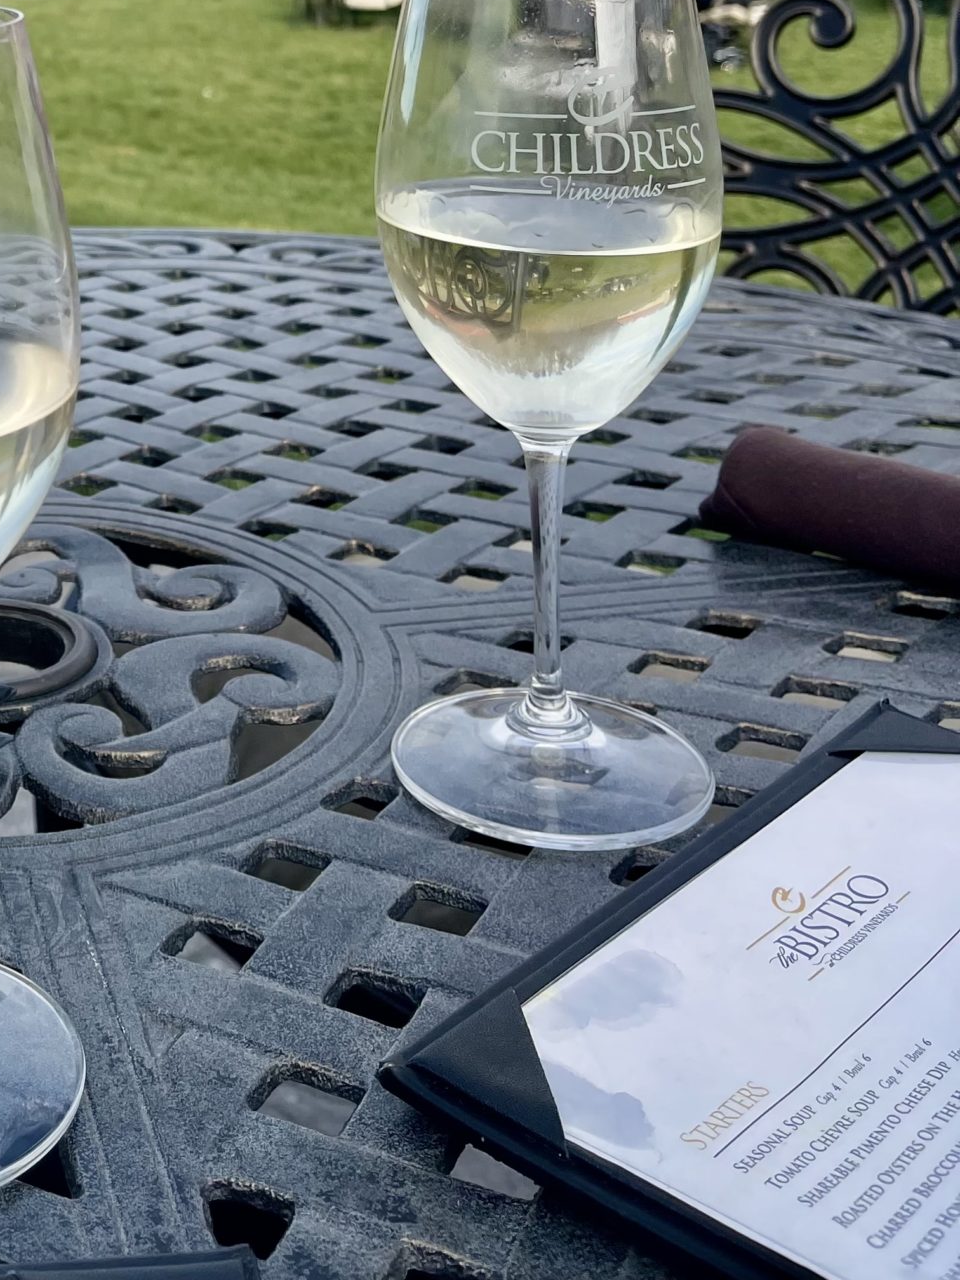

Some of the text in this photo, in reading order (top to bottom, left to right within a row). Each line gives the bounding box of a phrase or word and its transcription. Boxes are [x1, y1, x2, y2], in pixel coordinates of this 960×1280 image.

[470, 123, 704, 174] CHILDRESS
[540, 175, 667, 208] Vineyards
[773, 874, 889, 961] BISTRO
[830, 930, 868, 961] CHILDRESS
[860, 903, 899, 933] VINEYARDS
[769, 945, 799, 969] the
[679, 1080, 770, 1151] STARTERS
[732, 1128, 792, 1174] SEASONAL
[783, 1104, 817, 1132] SOUP
[815, 1091, 838, 1106] Cup
[831, 1082, 842, 1092] 4
[843, 1058, 866, 1079] Bowl
[862, 1052, 872, 1062] 6
[763, 1150, 816, 1191] TOMATO
[847, 1089, 880, 1118] SOUP
[878, 1075, 900, 1090] Cup
[893, 1066, 904, 1076] 4
[904, 1043, 926, 1063] Bowl
[922, 1037, 933, 1047] 6
[797, 1061, 951, 1208] SHAREABLE PIMENTO CHEESE DIP
[831, 1101, 960, 1229] ROASTED OYSTERS ON THE
[866, 1197, 922, 1249] CHARRED
[900, 1227, 946, 1270] SPICED
